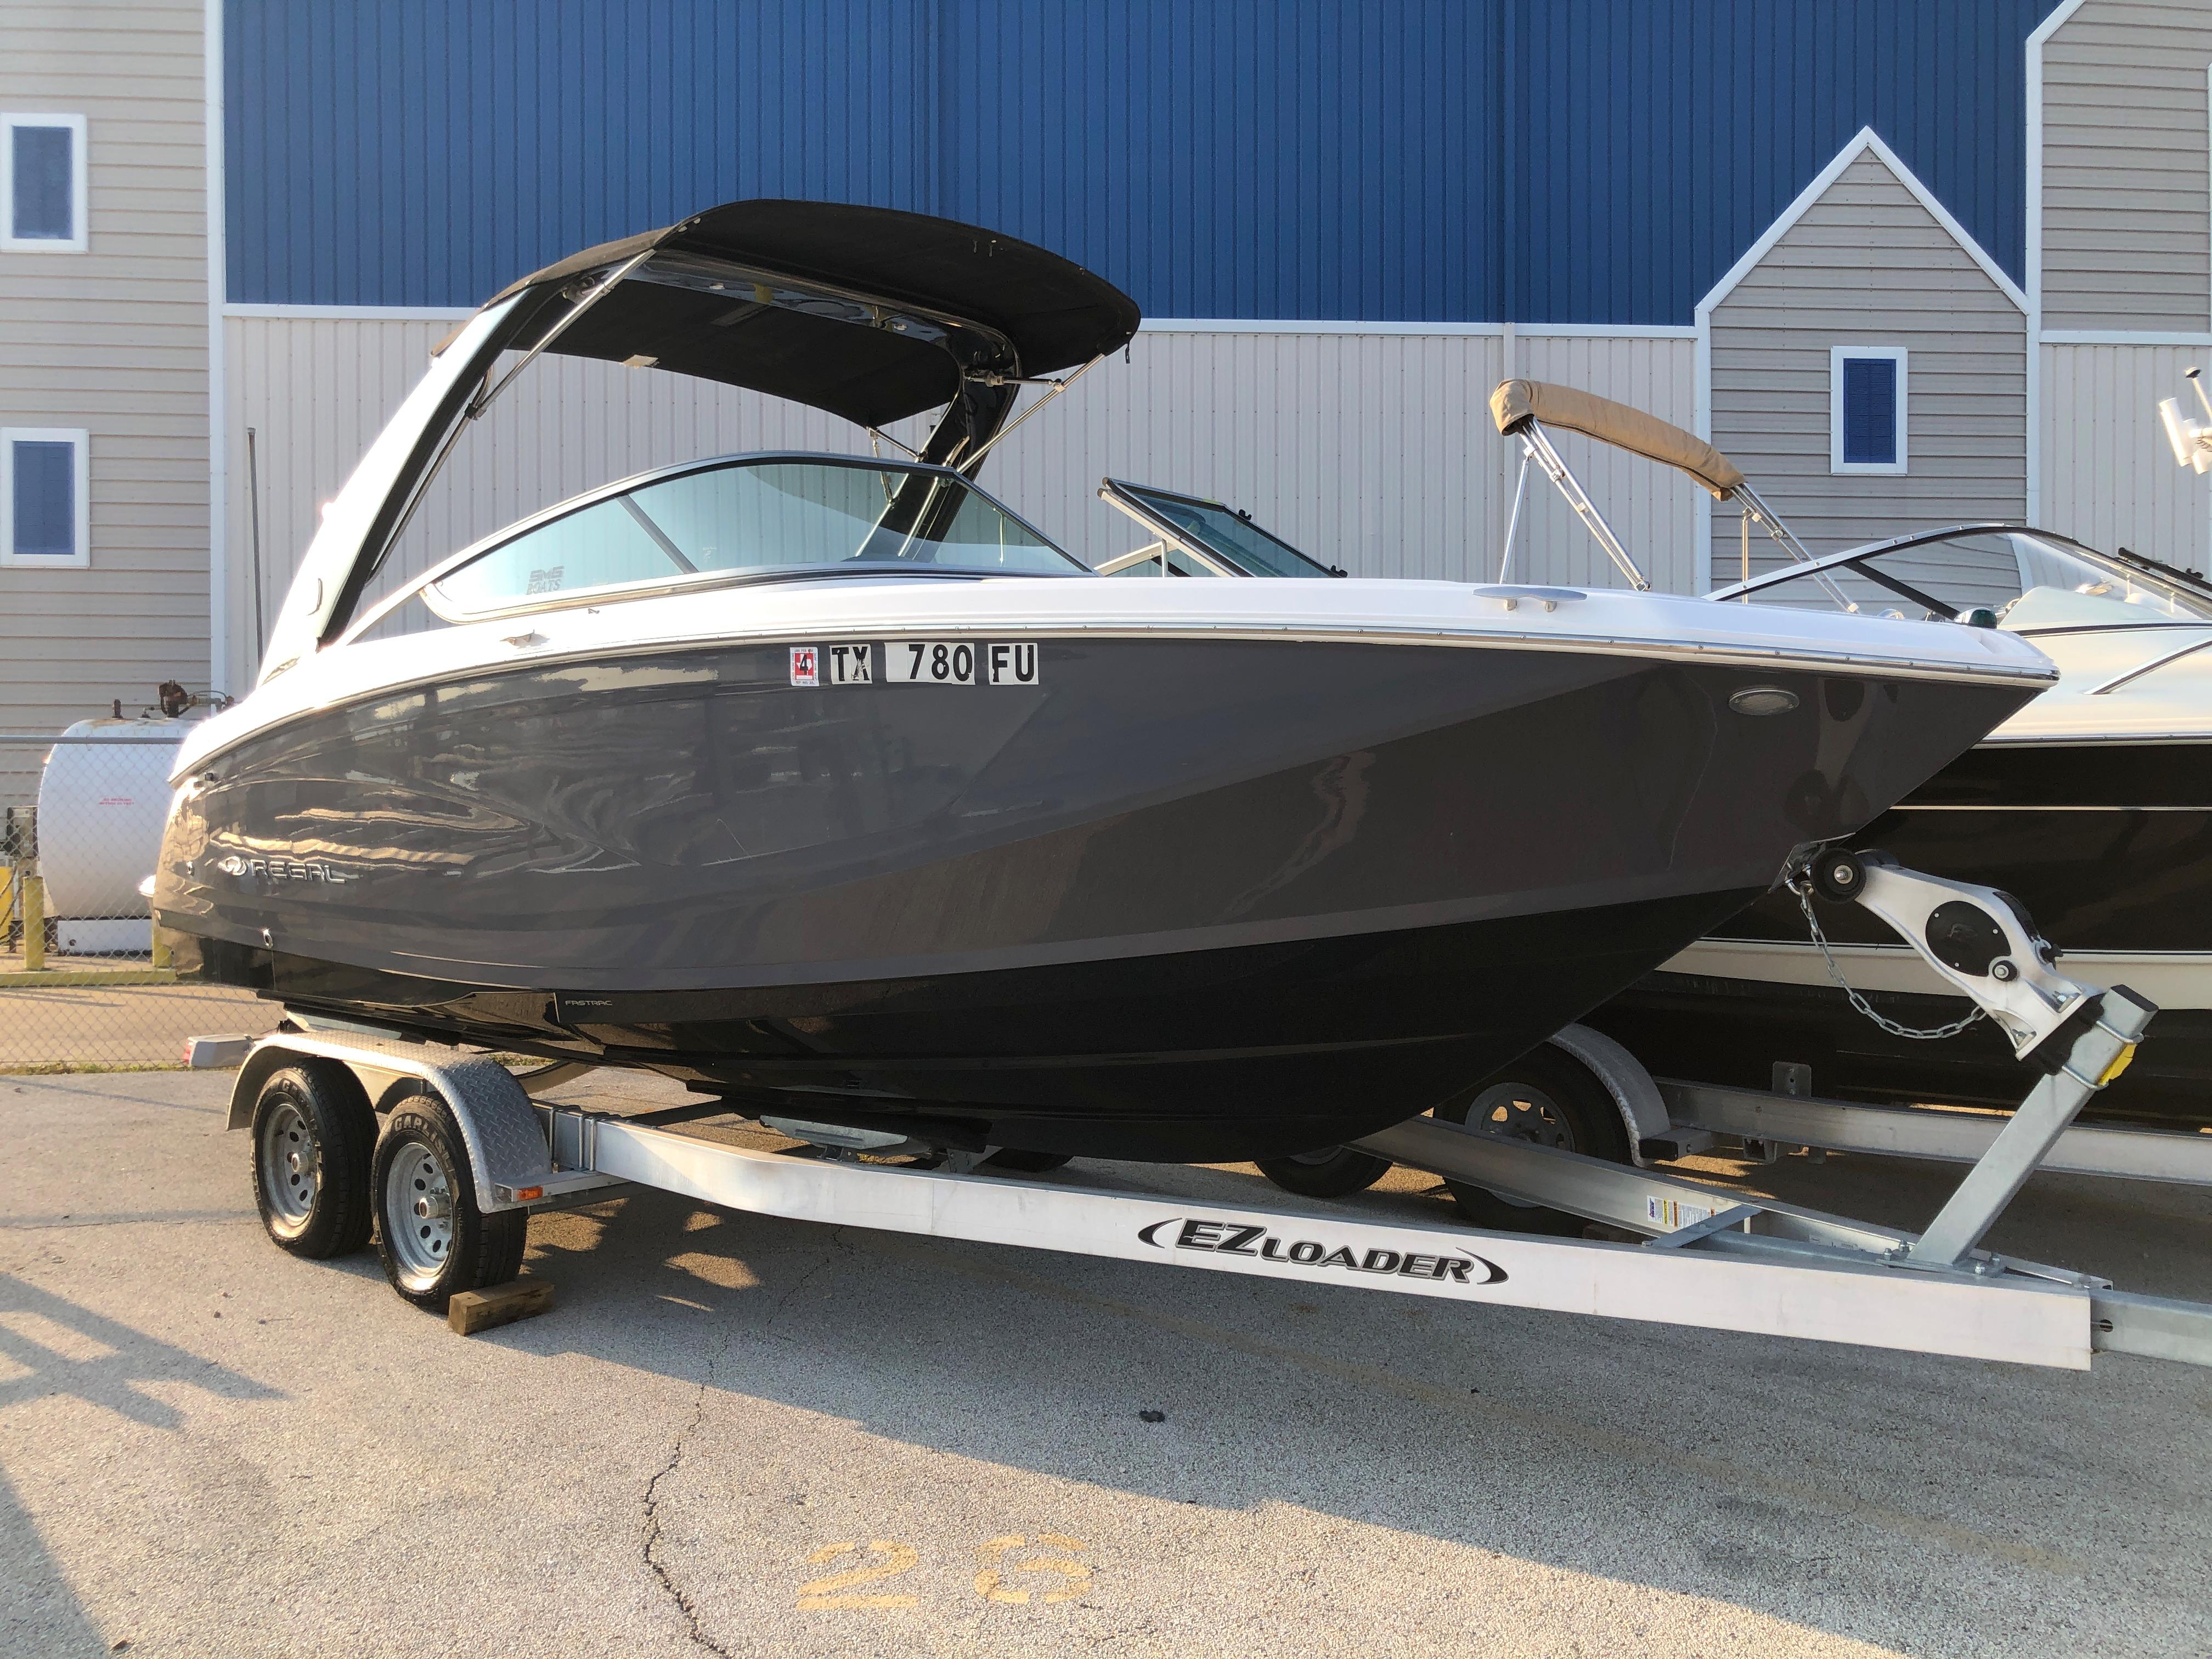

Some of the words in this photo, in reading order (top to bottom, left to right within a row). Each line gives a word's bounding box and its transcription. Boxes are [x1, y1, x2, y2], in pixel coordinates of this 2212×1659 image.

[526, 579, 562, 595] BOATS
[799, 654, 808, 675] 4
[831, 646, 871, 681] TX
[908, 644, 973, 682] 780
[992, 645, 1035, 682] FU
[250, 858, 346, 884] REGAL
